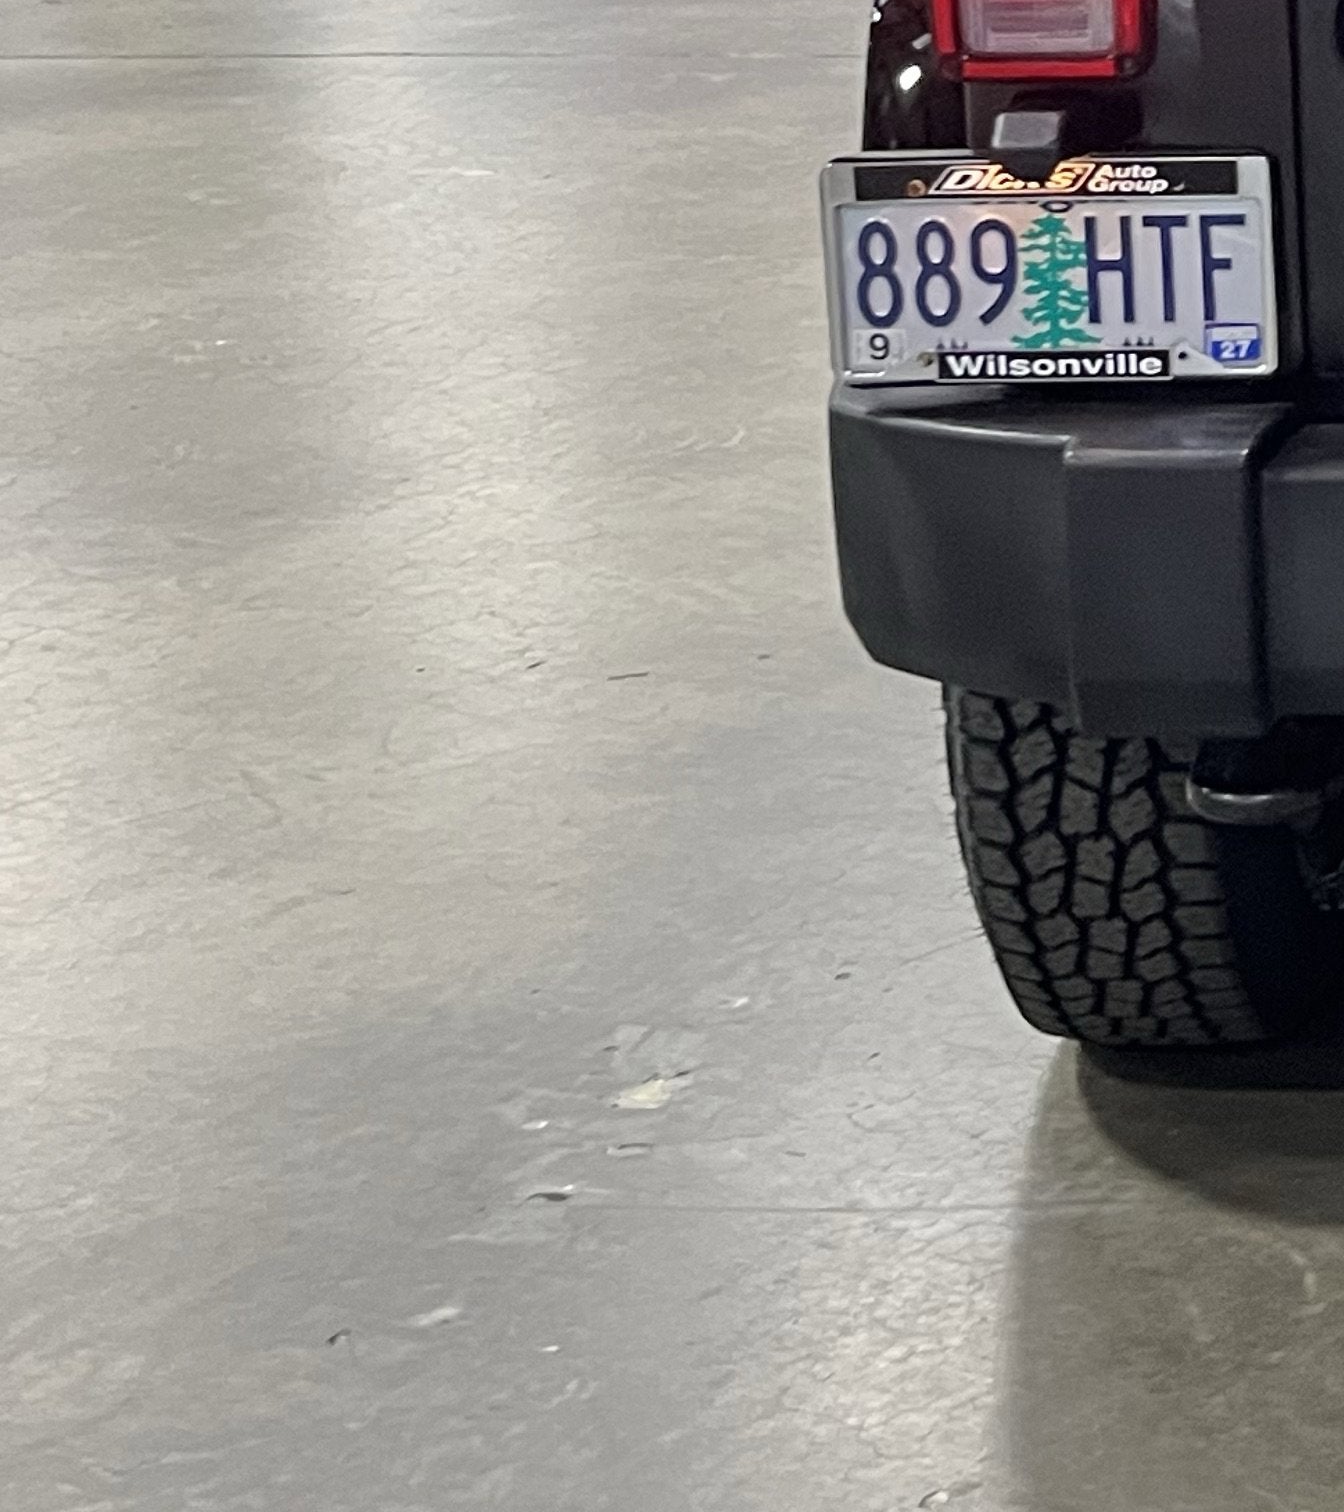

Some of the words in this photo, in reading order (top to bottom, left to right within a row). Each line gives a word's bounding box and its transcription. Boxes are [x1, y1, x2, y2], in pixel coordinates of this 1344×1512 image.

[1095, 164, 1158, 179] Auto
[1087, 177, 1170, 195] Group
[856, 218, 1021, 328] 889
[1084, 213, 1248, 325] HTF
[868, 334, 891, 361] 9
[1220, 340, 1252, 360] 27
[945, 352, 1164, 378] Wilsonville
